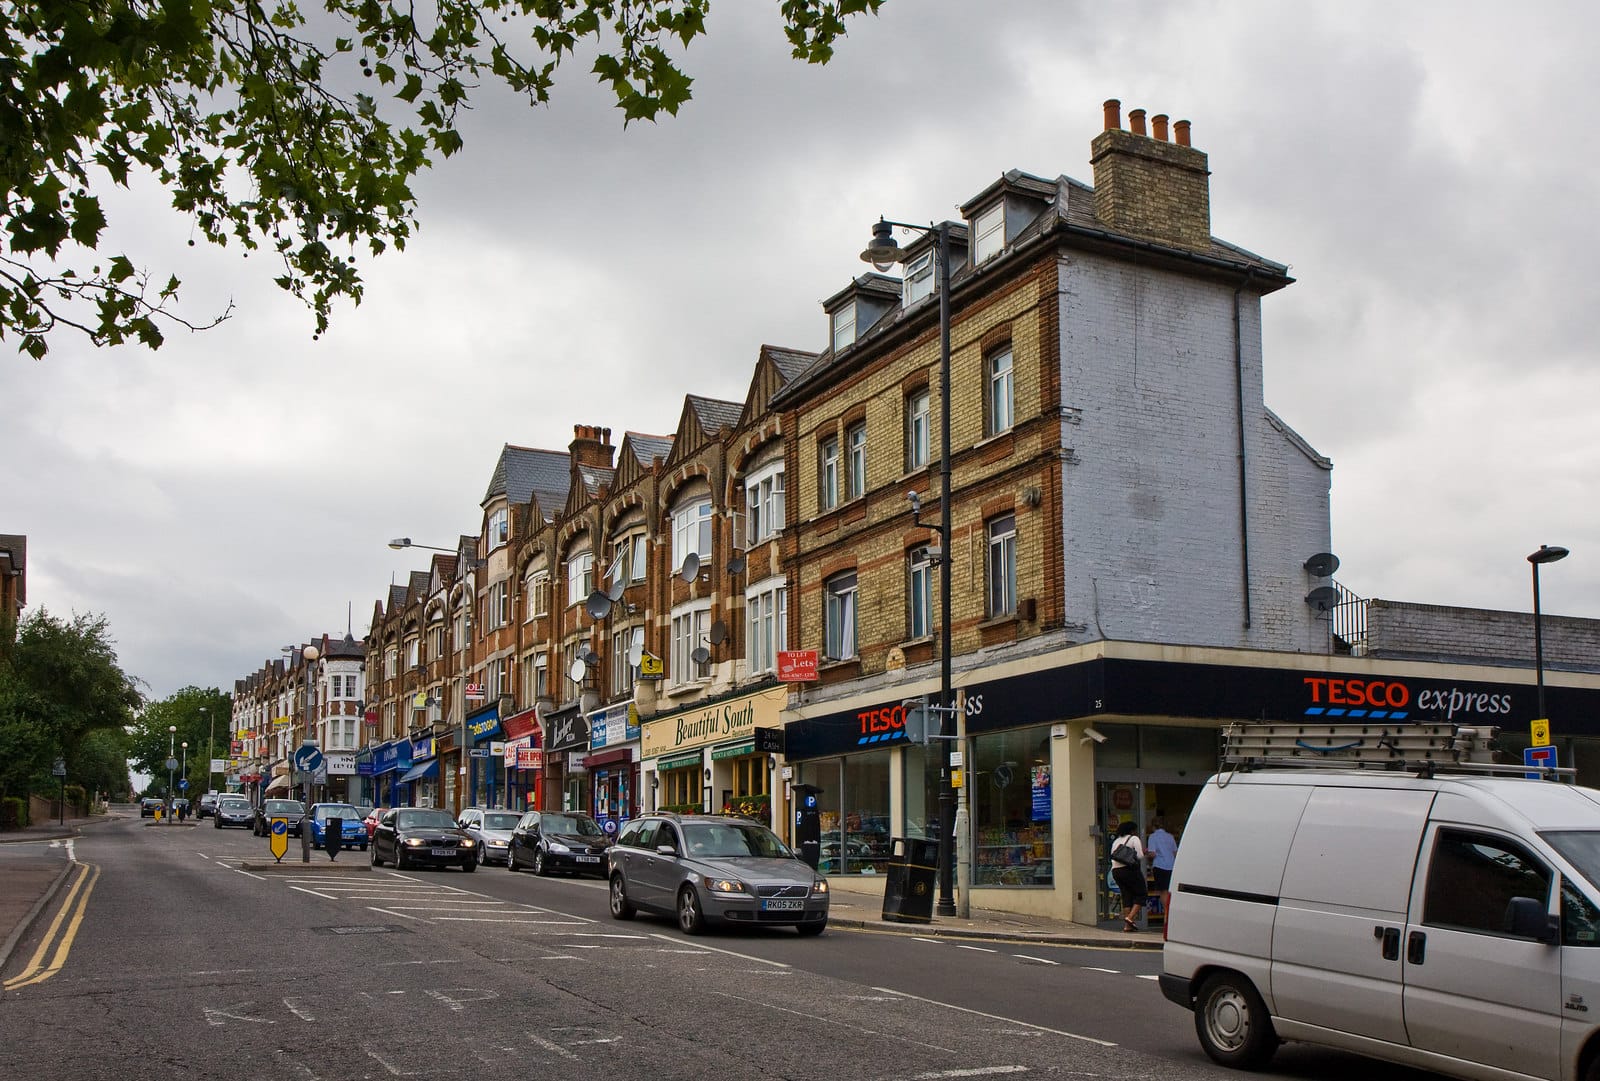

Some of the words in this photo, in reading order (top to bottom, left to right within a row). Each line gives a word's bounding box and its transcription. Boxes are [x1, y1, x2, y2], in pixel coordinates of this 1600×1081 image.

[792, 658, 814, 668] Lets
[1303, 677, 1410, 708] TESCO
[1417, 688, 1512, 720] express
[1095, 699, 1102, 709] 25
[675, 709, 720, 746] Beautiful
[722, 700, 754, 735] South
[763, 741, 780, 750] CASH
[767, 901, 787, 909] RK05
[788, 901, 803, 909] ZKR
